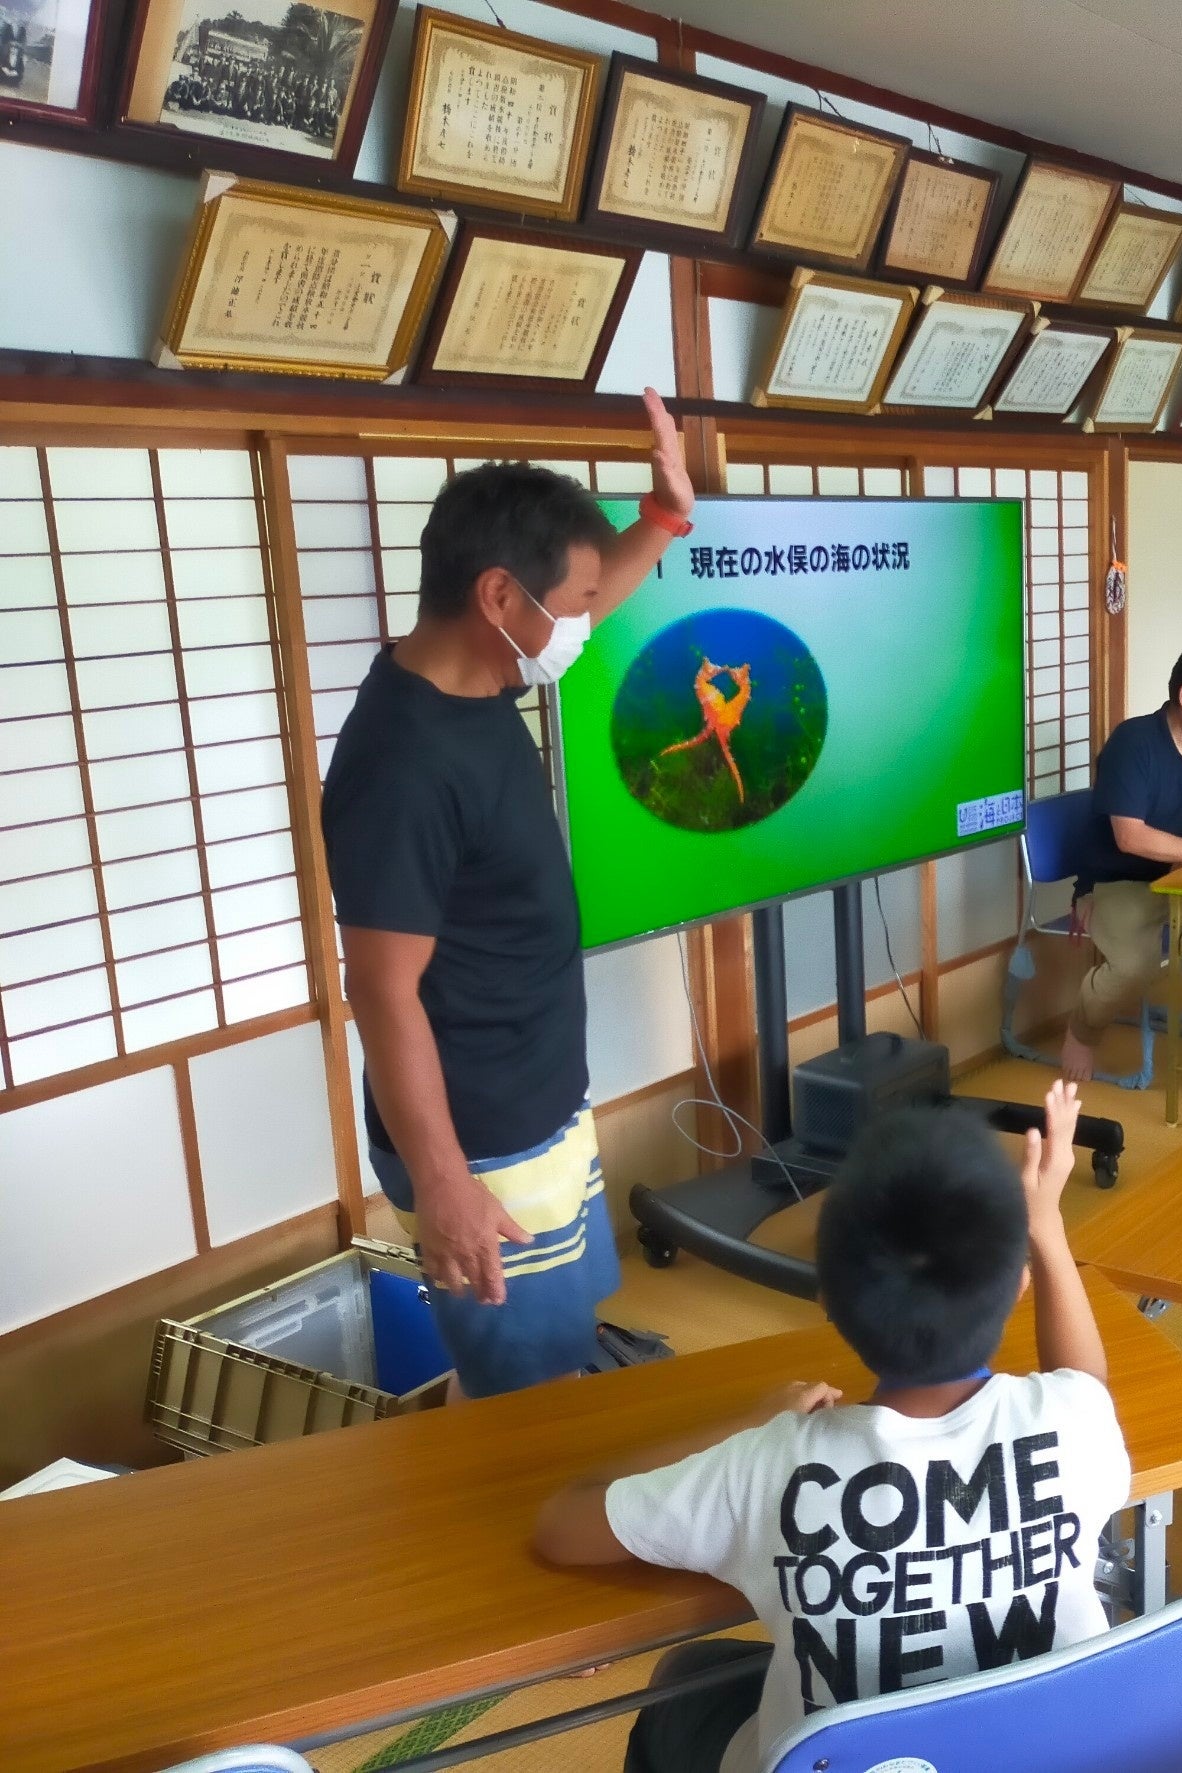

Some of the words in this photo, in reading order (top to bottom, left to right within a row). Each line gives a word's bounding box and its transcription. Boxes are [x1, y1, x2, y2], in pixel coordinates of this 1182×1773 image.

[689, 541, 911, 579] 現在の水俣の海の状況
[779, 1431, 1065, 1556] COME
[773, 1511, 1081, 1617] TOGETHER
[792, 1581, 1060, 1716] NEW
